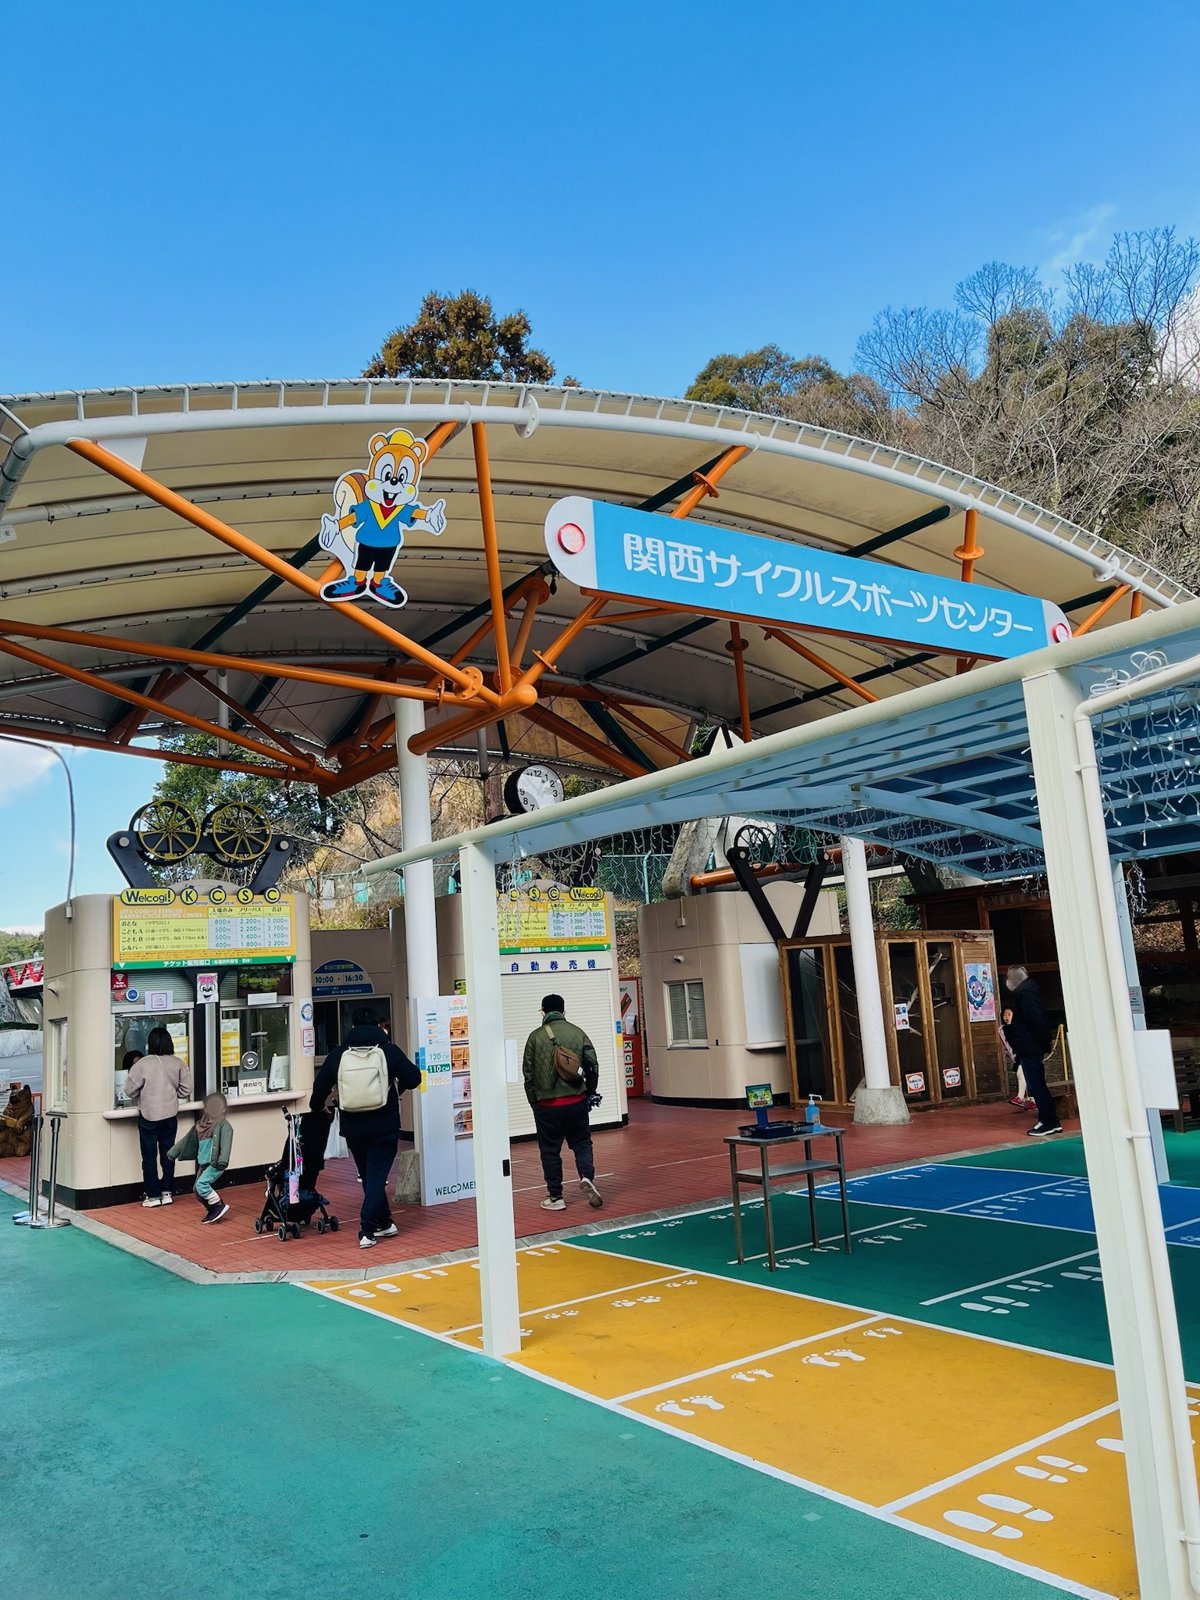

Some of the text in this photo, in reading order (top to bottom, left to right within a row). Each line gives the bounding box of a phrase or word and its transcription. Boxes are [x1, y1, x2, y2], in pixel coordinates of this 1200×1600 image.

[623, 532, 1034, 637] 関西サイクルスポーツセンター
[125, 889, 277, 904] Welcogi! K C S C
[550, 888, 558, 898] C
[511, 959, 596, 972] 自動券売機
[315, 974, 364, 984] 10:00 16:30
[435, 1180, 477, 1196] WELCOME!
